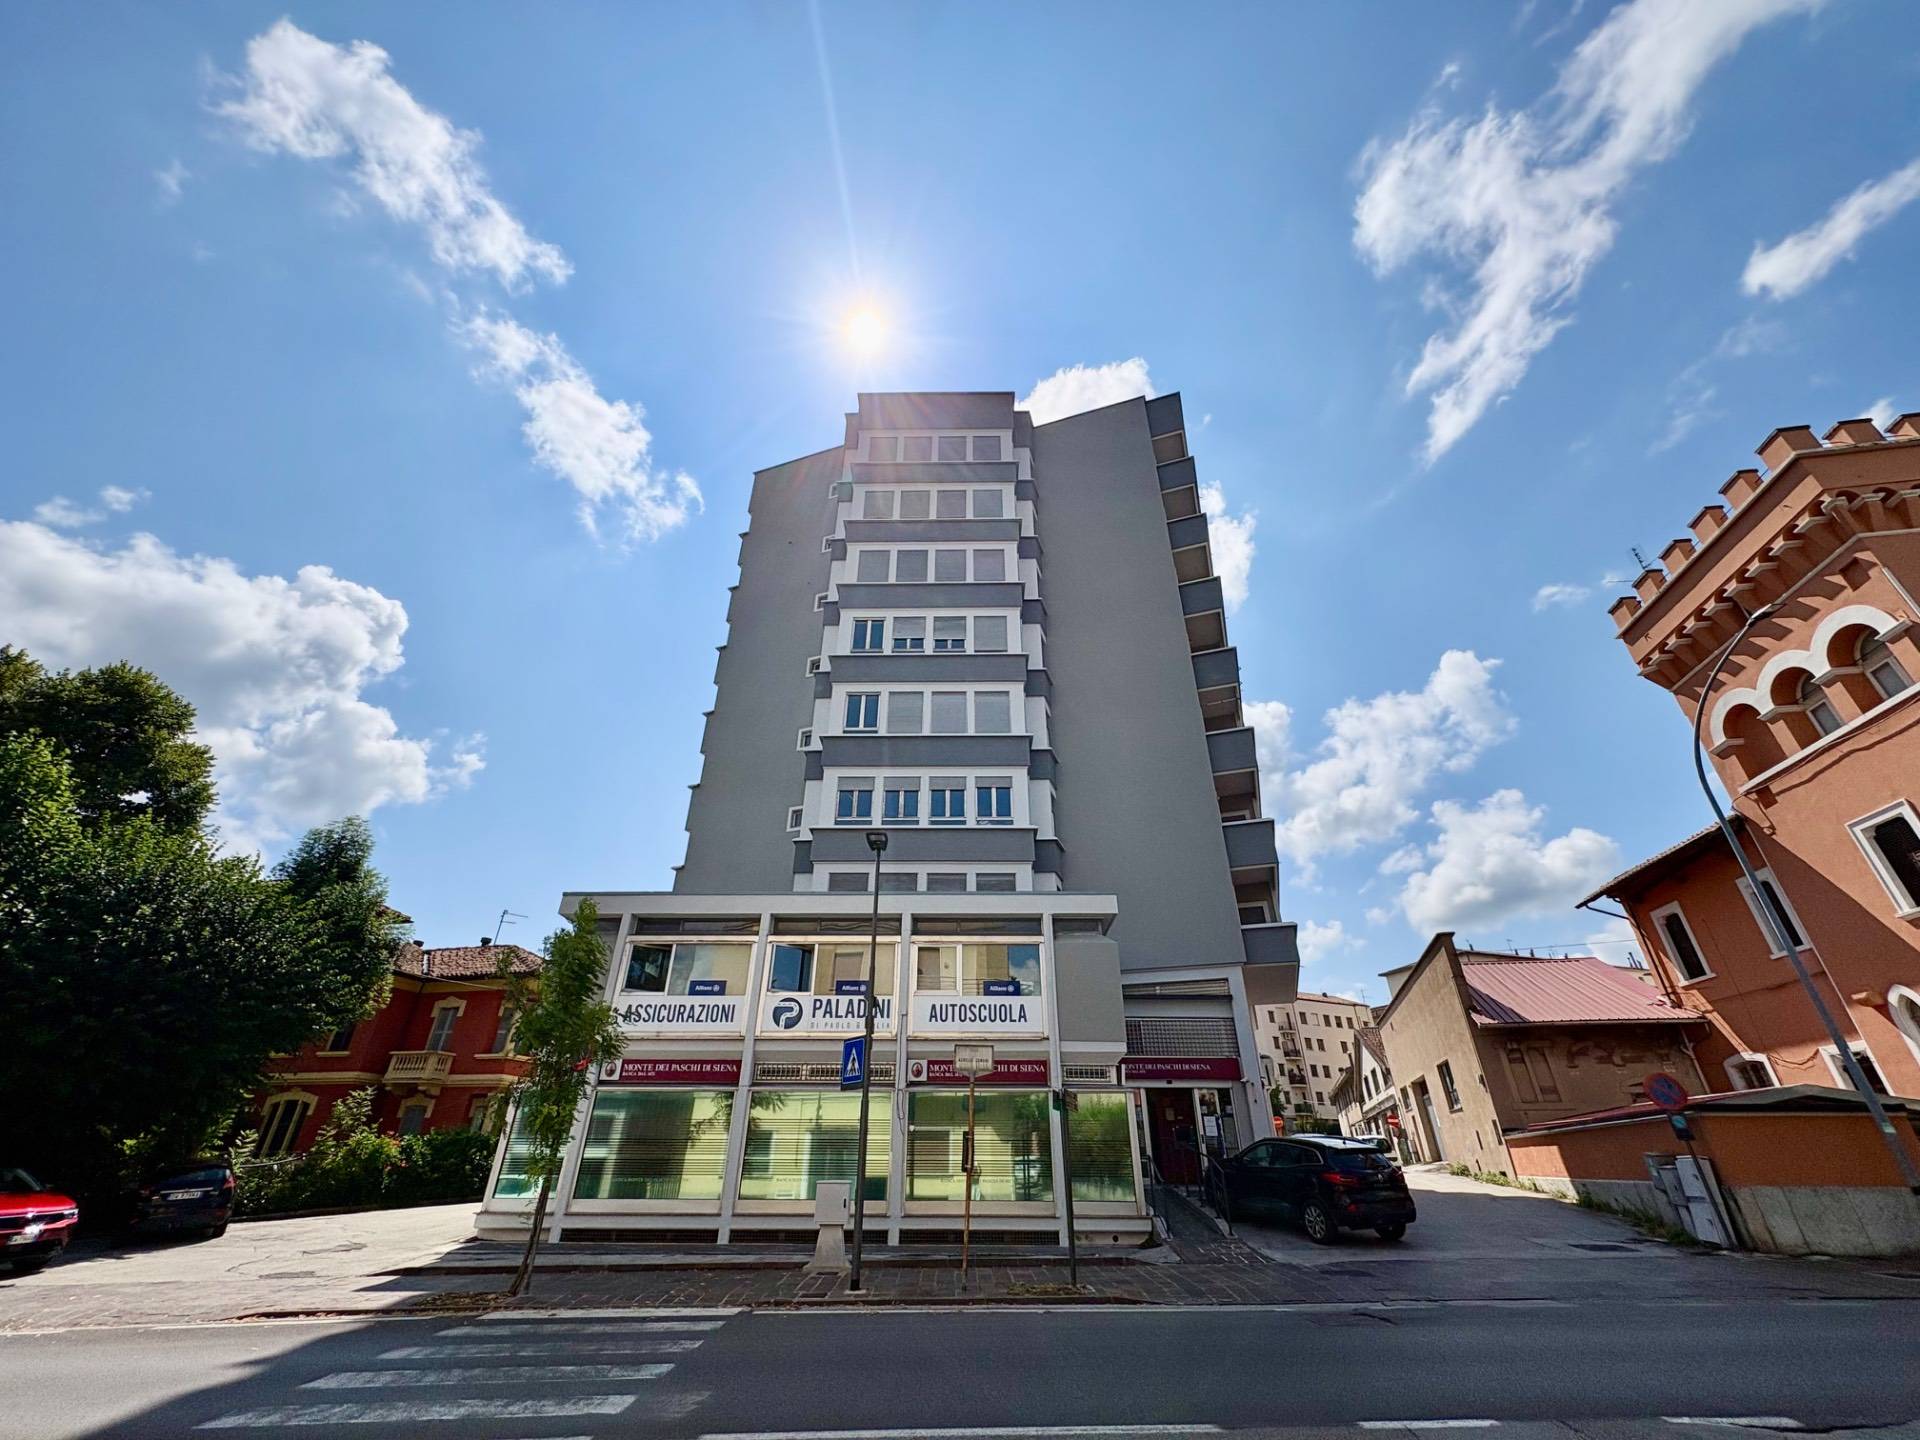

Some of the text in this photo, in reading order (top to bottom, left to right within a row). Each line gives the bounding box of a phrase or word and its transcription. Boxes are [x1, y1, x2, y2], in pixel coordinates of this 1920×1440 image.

[622, 1003, 736, 1023] ASSICURAZIONI
[812, 998, 891, 1019] PALADNI
[928, 1003, 1028, 1023] AUTOSCUOLA
[623, 1063, 737, 1072] MONTE DEI PASCHI DI SIENA
[929, 1064, 953, 1072] MONT
[1009, 1064, 1018, 1072] DI
[1020, 1064, 1045, 1072] SIENA
